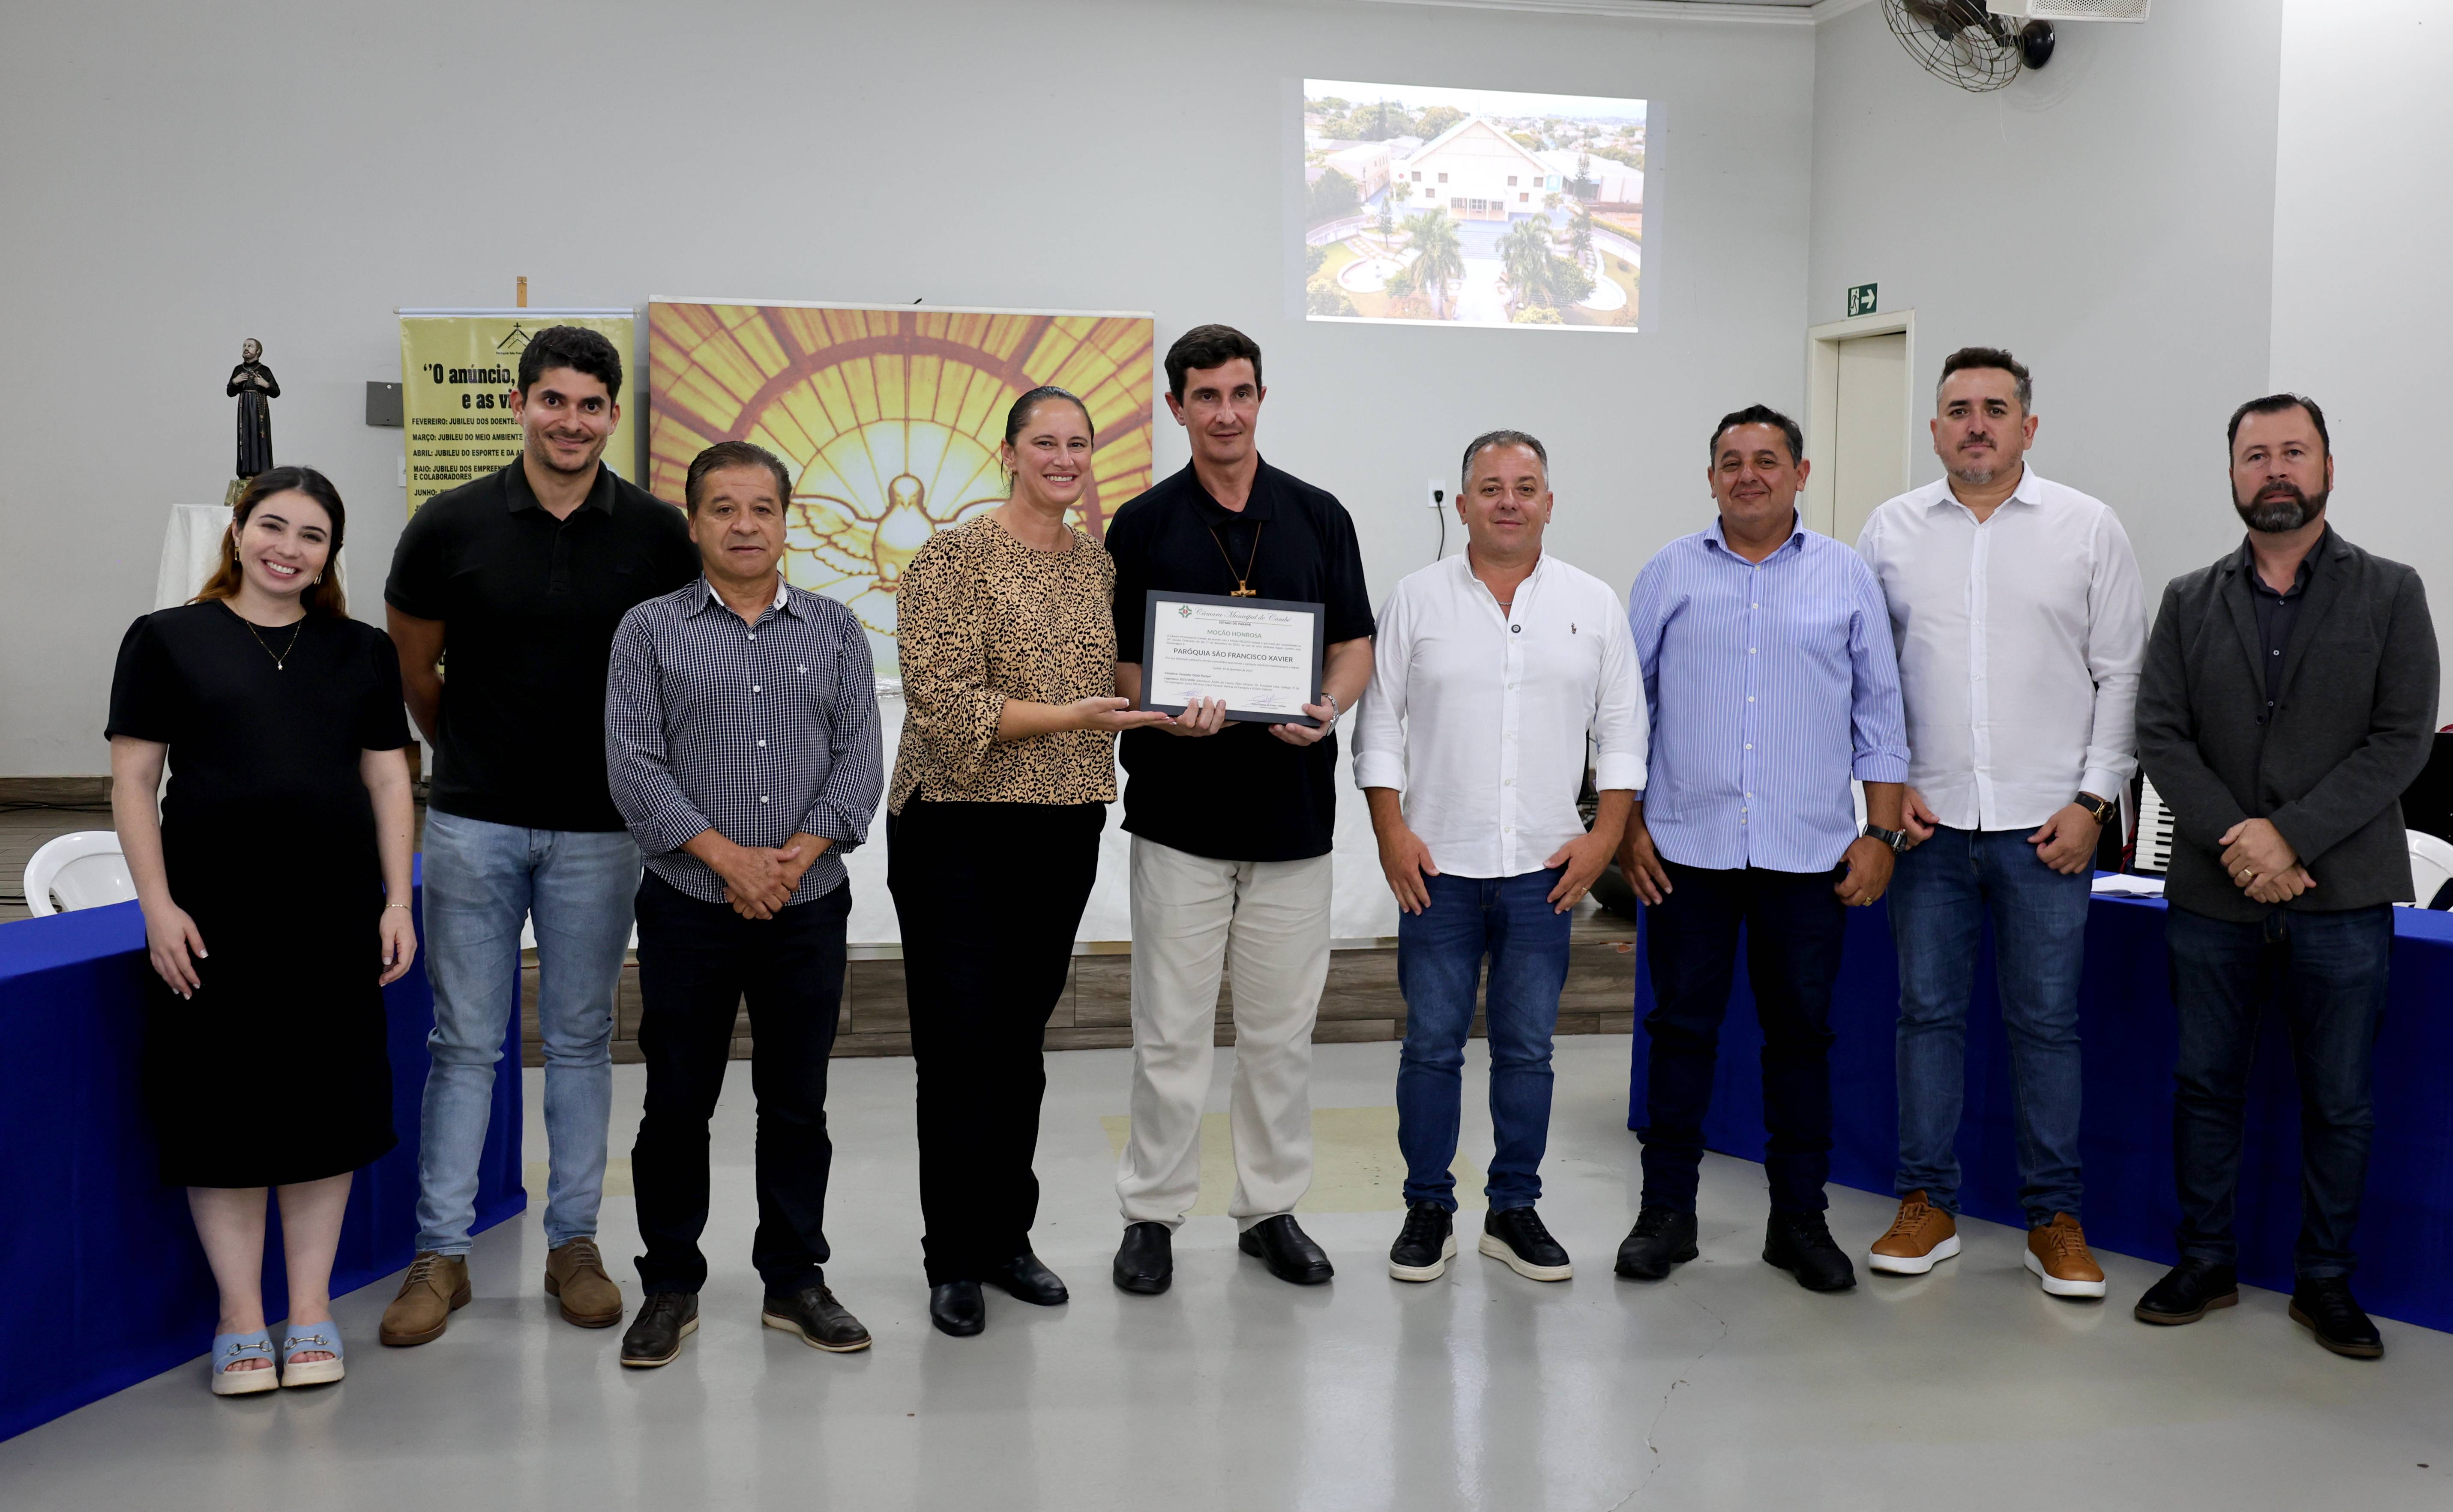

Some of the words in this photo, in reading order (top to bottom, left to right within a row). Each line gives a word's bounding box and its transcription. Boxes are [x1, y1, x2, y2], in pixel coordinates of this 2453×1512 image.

[449, 363, 515, 386] anúncio,
[462, 394, 471, 409] e
[476, 394, 494, 409] as
[1195, 608, 1222, 617] Câmara
[1224, 609, 1258, 621] Municipal
[1268, 613, 1292, 622] Cambé
[1174, 648, 1210, 656] PARÓQUIA
[1228, 652, 1267, 661] FRANCISCO
